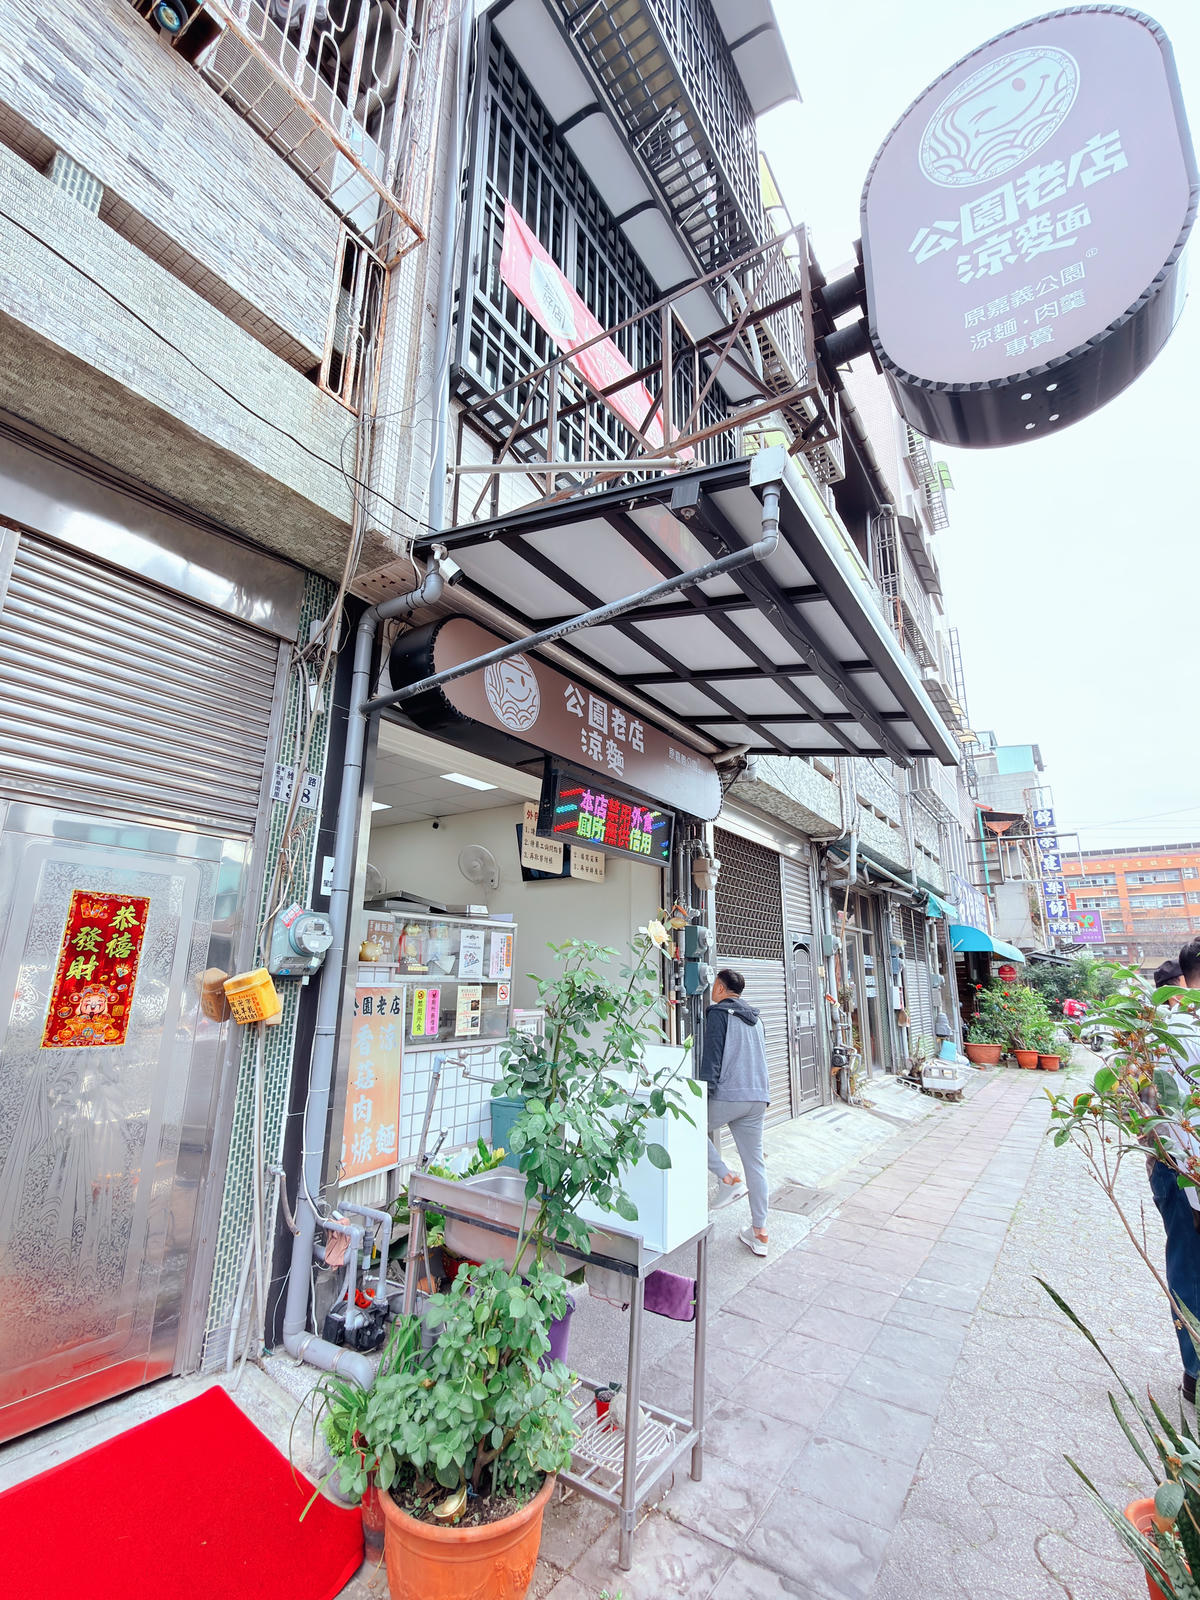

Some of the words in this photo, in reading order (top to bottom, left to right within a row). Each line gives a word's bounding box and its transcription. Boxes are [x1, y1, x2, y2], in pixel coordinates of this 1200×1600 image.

[908, 129, 1129, 264] 公園老店
[964, 261, 1086, 329] 原嘉義公園
[1004, 325, 1055, 356] 專賣
[564, 683, 645, 753] 公園老店
[581, 728, 625, 776] 涼麵
[65, 926, 104, 981] 發財
[105, 905, 140, 959] 恭禧
